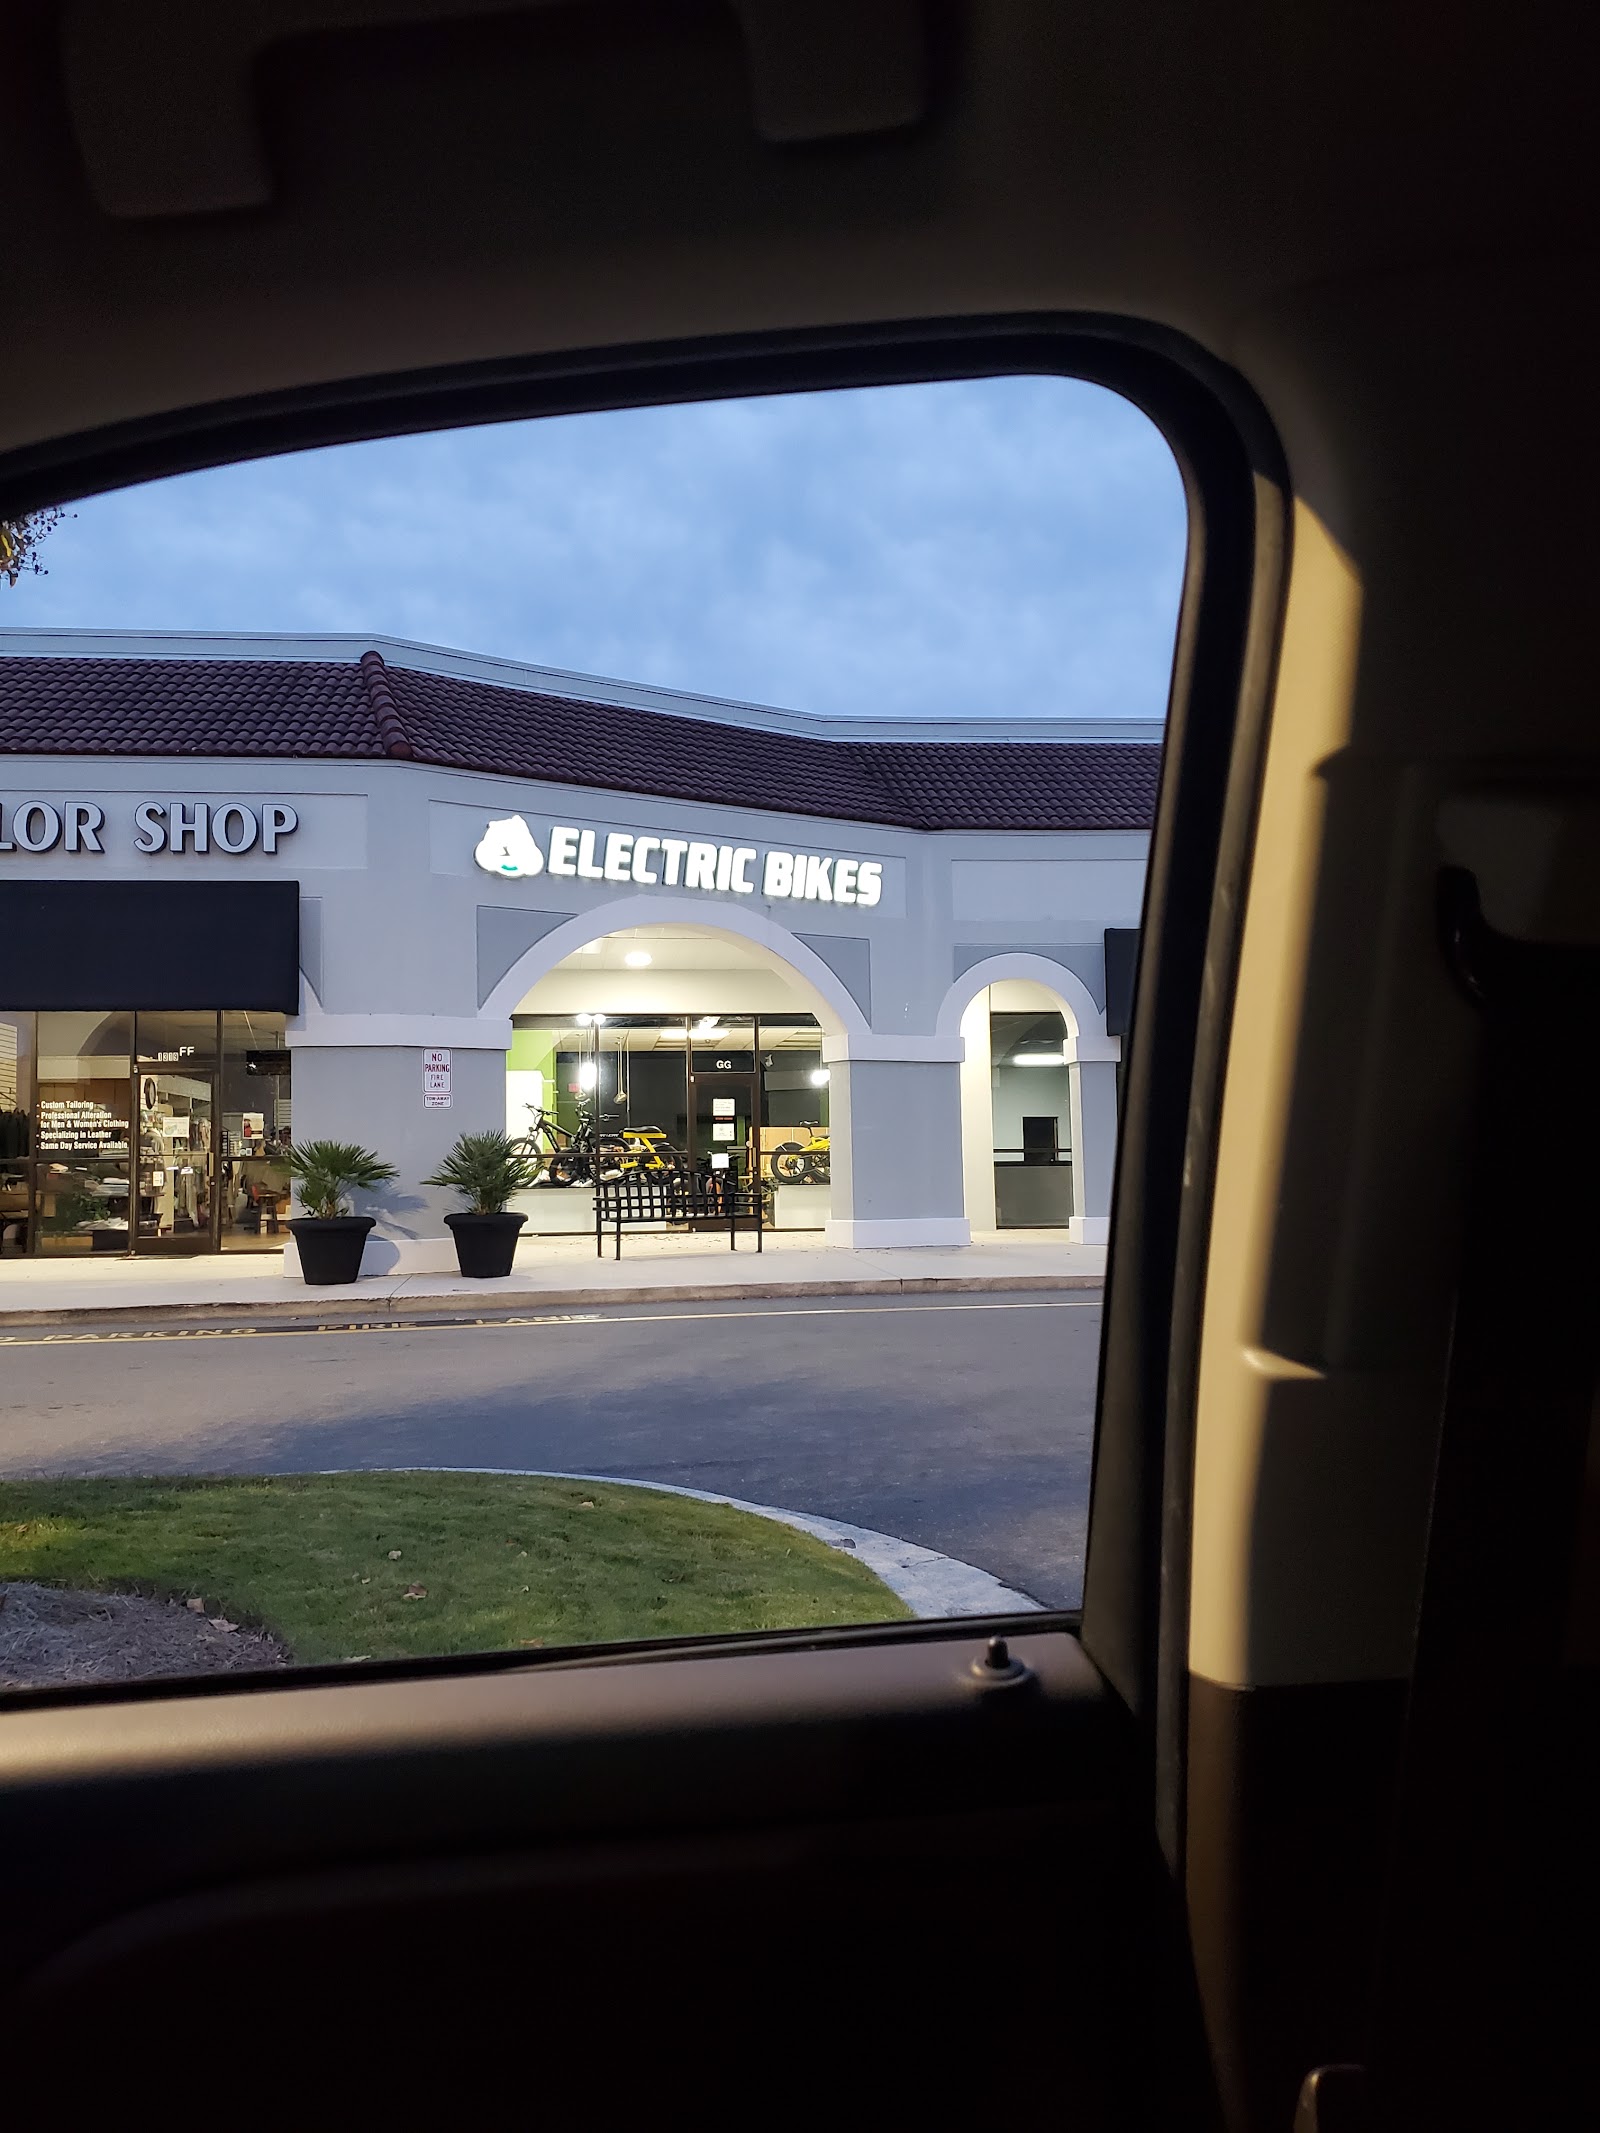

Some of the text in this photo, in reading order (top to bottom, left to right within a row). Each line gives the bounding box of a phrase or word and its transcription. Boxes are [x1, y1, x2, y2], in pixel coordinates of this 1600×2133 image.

[0, 800, 298, 853] OR SHOP
[547, 826, 883, 906] ELECTRIC BIKES
[180, 1046, 195, 1057] FF
[431, 1053, 443, 1062] NO
[425, 1063, 450, 1073] PARKING
[716, 1060, 732, 1069] GG
[41, 1101, 94, 1110] Custom Tailoring
[41, 1120, 129, 1129] for Men & Women's Clothing
[41, 1131, 79, 1140] Specializing
[60, 1142, 73, 1151] Day
[73, 1141, 97, 1149] Service
[99, 1141, 128, 1149] Available
[318, 1313, 602, 1331] FIRE LANE
[43, 1328, 257, 1341] PARKING
